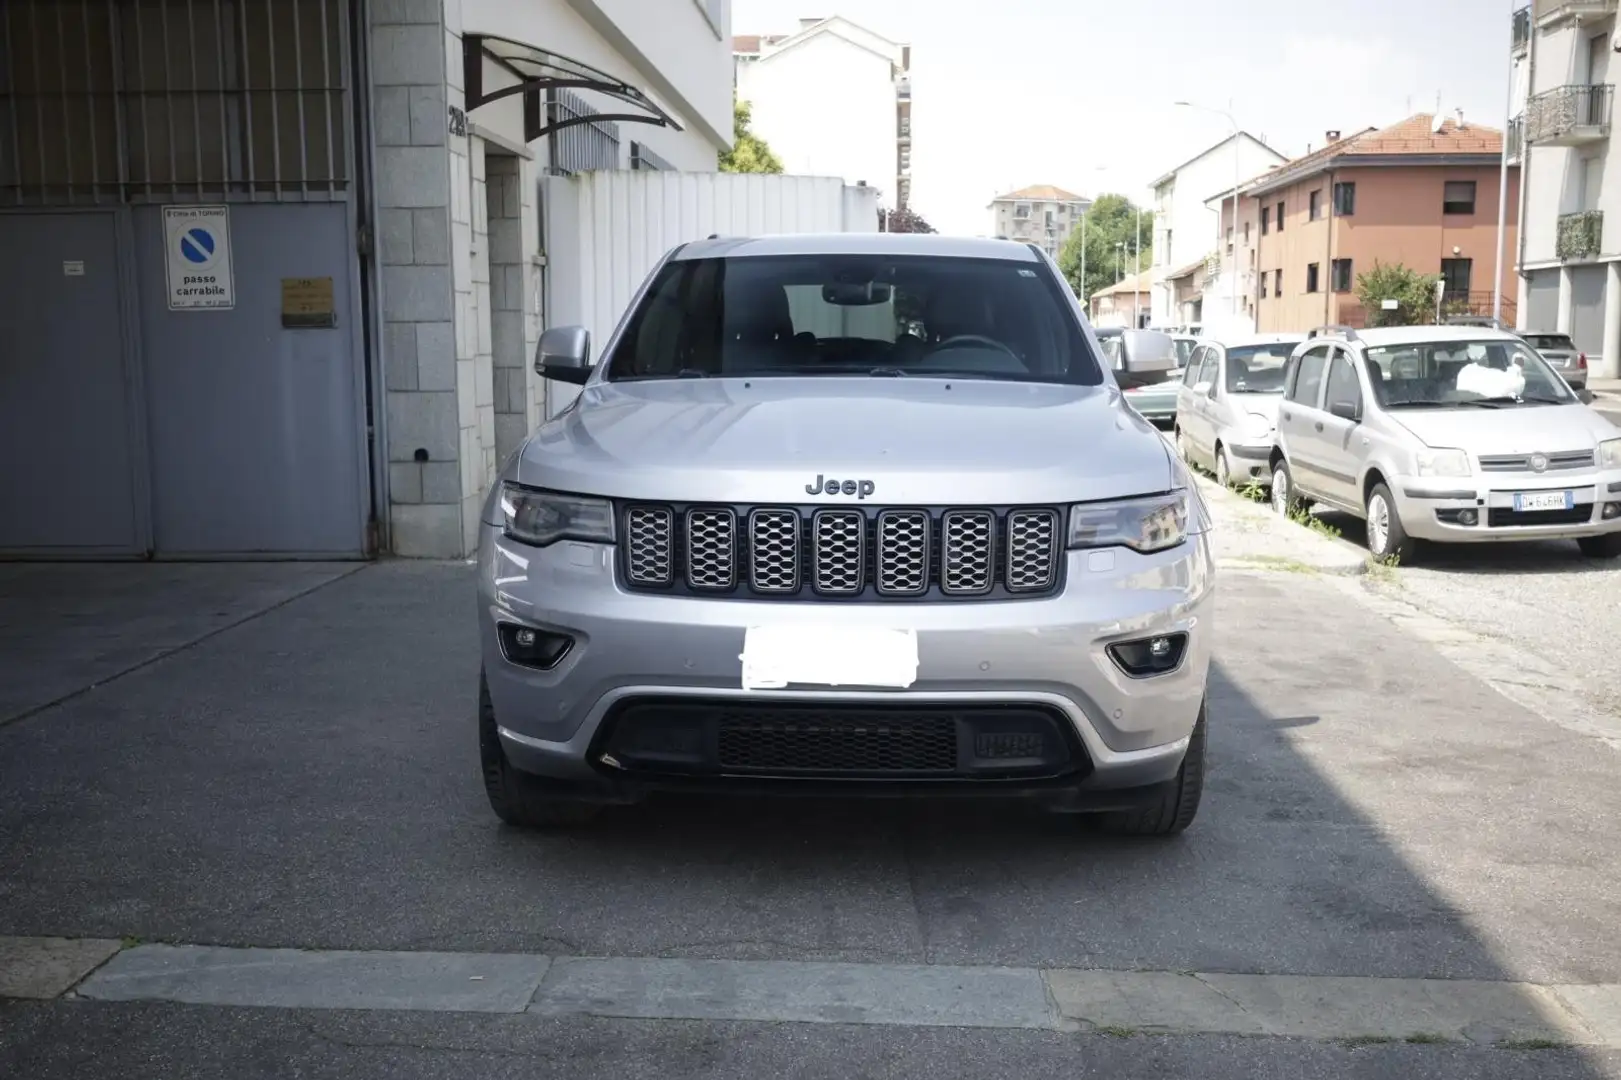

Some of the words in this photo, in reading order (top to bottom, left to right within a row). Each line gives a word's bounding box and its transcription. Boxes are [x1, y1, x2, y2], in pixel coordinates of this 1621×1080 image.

[183, 276, 216, 285] passo
[176, 286, 225, 296] carrabile
[805, 474, 875, 500] Jeep
